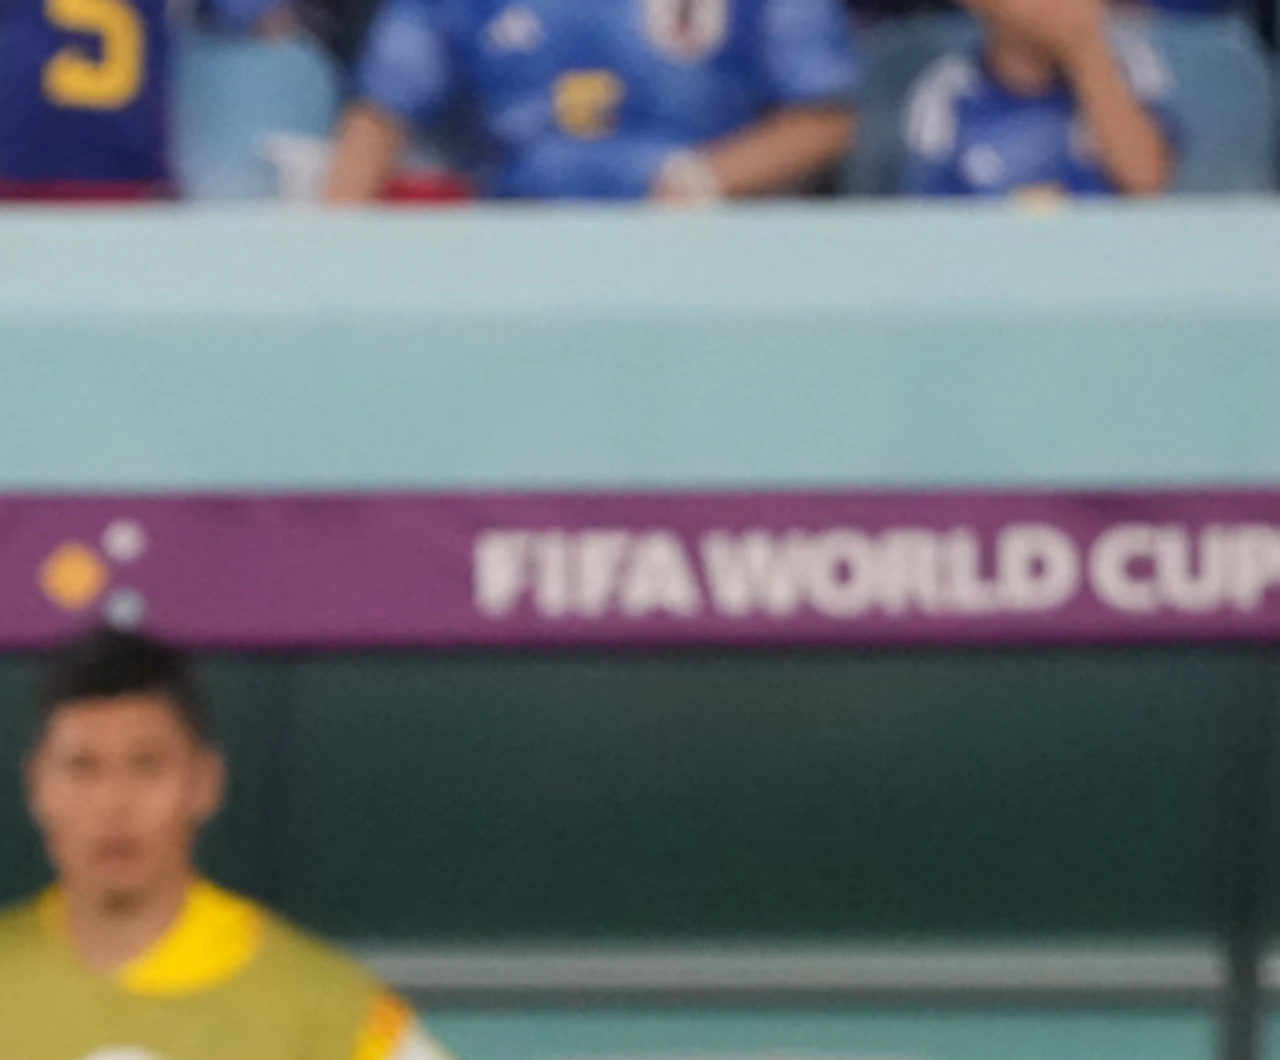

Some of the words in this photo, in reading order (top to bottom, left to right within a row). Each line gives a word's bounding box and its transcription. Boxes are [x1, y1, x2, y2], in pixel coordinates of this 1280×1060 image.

[473, 528, 700, 618] FIFA
[700, 522, 1080, 617] WORLD
[1088, 521, 1280, 614] CUP
